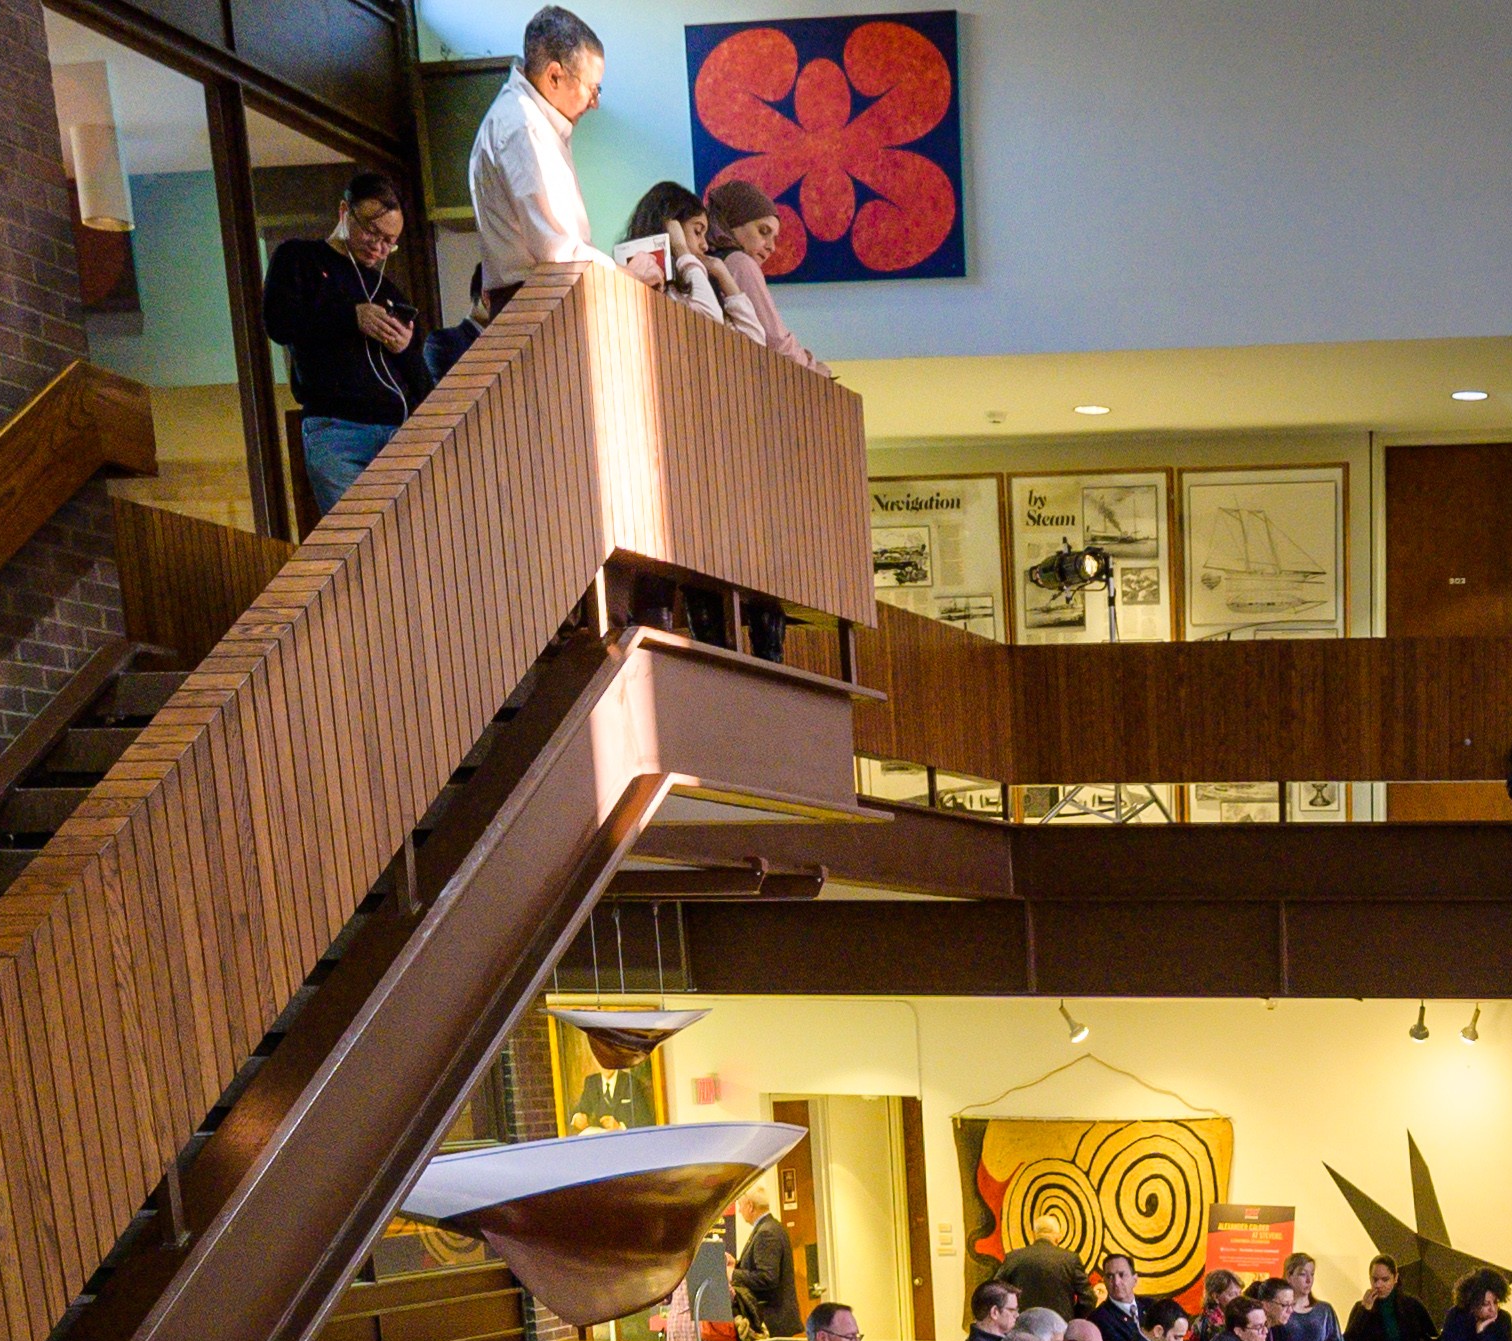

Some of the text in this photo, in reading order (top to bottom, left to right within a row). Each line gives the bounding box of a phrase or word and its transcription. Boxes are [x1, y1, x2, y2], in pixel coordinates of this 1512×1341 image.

[872, 492, 961, 513] Navigation
[1027, 488, 1048, 509] by
[1025, 509, 1076, 527] Steam
